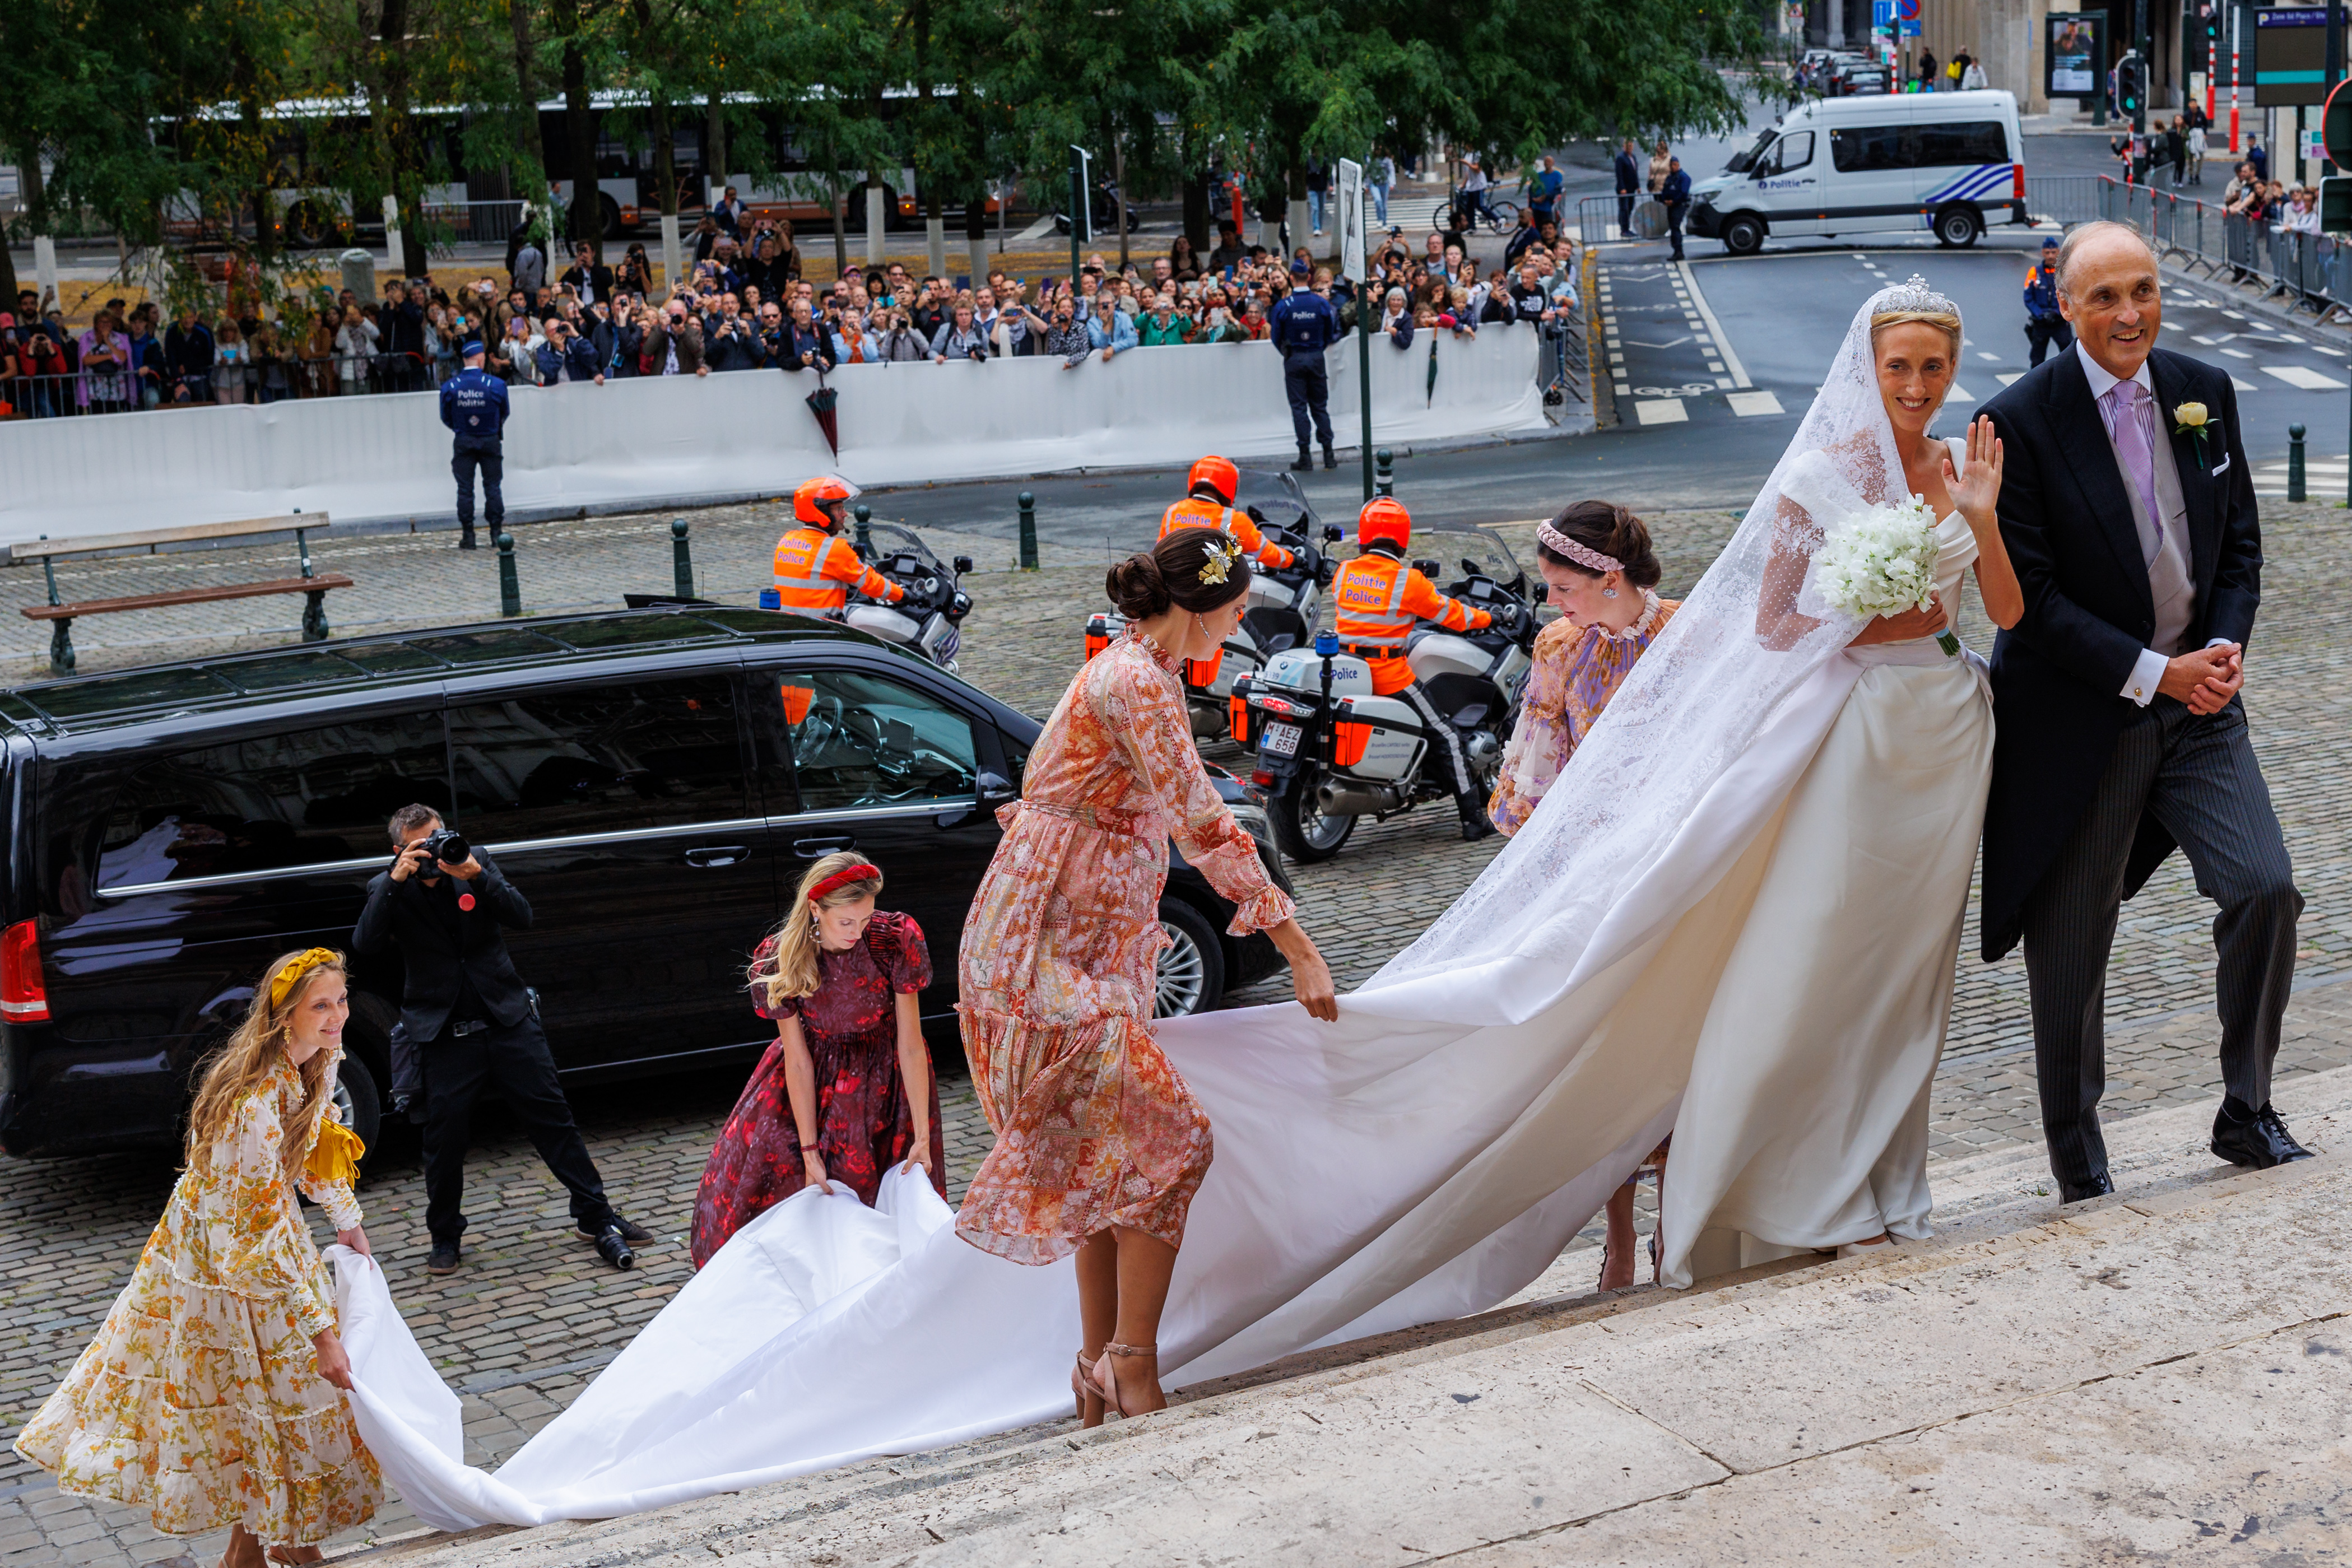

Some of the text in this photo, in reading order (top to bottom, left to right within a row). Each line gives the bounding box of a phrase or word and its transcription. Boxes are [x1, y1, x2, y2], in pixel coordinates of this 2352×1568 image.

[1770, 179, 1800, 188] Politie
[1293, 311, 1316, 319] Police
[458, 389, 484, 398] Police
[457, 399, 486, 407] Politie
[1175, 514, 1211, 526] Politie
[780, 538, 812, 551] Politie
[778, 551, 805, 565] Police
[1347, 573, 1386, 589] Politie
[1346, 589, 1381, 605] Police
[1332, 668, 1358, 680] Police
[1275, 739, 1295, 752] 658
